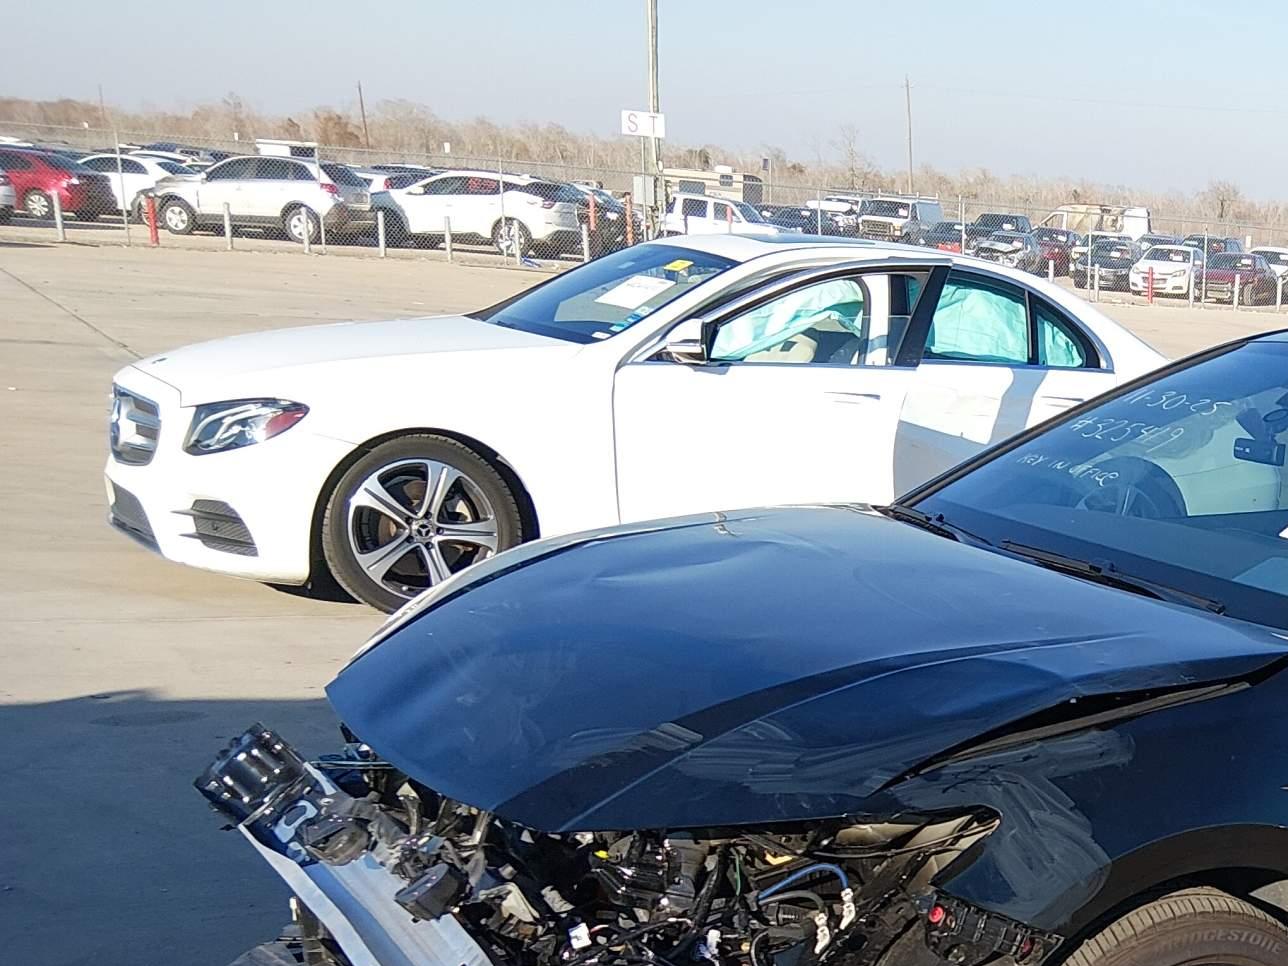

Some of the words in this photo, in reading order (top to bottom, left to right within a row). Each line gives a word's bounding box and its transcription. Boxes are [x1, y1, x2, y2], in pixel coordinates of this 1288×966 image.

[627, 113, 639, 133] S
[648, 115, 658, 136] T
[1048, 459, 1072, 469] IN
